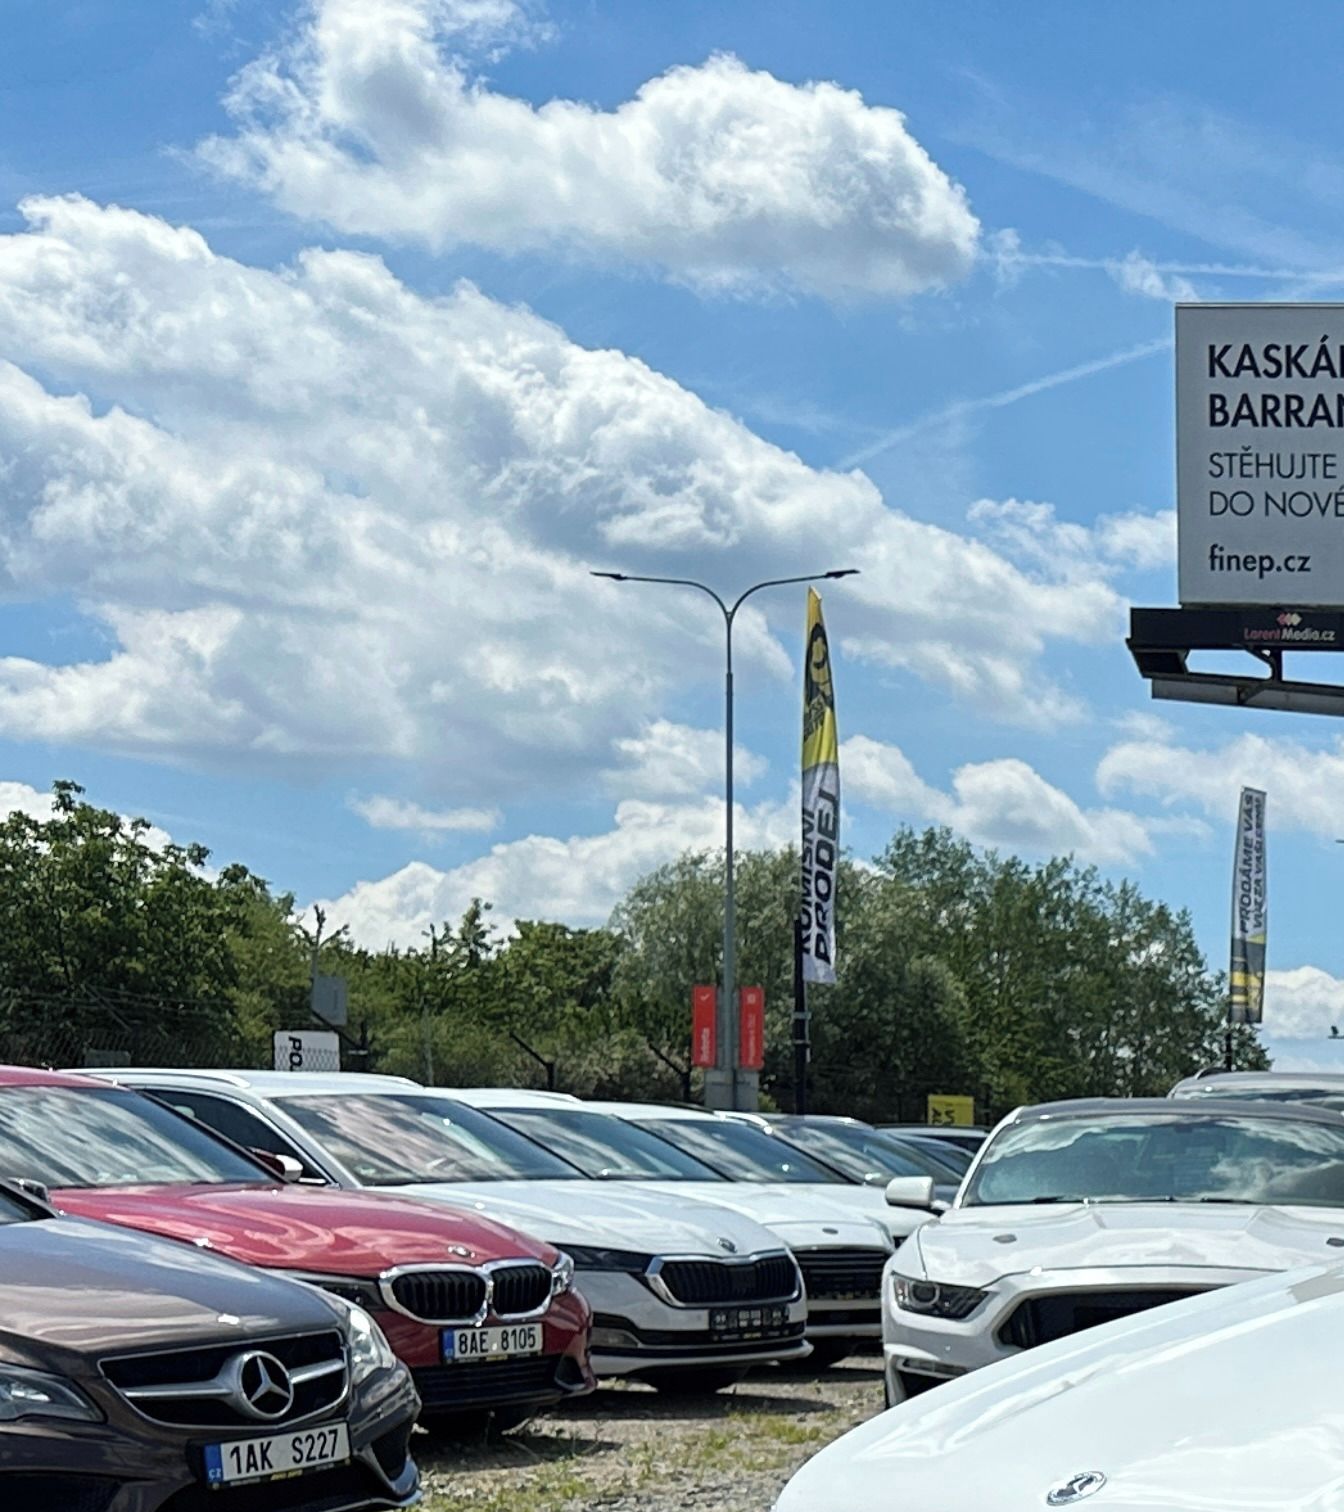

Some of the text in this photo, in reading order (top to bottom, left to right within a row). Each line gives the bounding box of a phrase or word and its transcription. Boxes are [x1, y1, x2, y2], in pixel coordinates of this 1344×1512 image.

[1207, 445, 1338, 480] STĚHUJTE
[1208, 490, 1256, 518] DO
[1208, 543, 1312, 580] finep.cz
[814, 787, 837, 966] PRODEJ
[288, 1036, 304, 1072] PO
[459, 1327, 536, 1355] 8AE 8105
[229, 1440, 274, 1475] 1AK
[291, 1428, 339, 1465] S227
